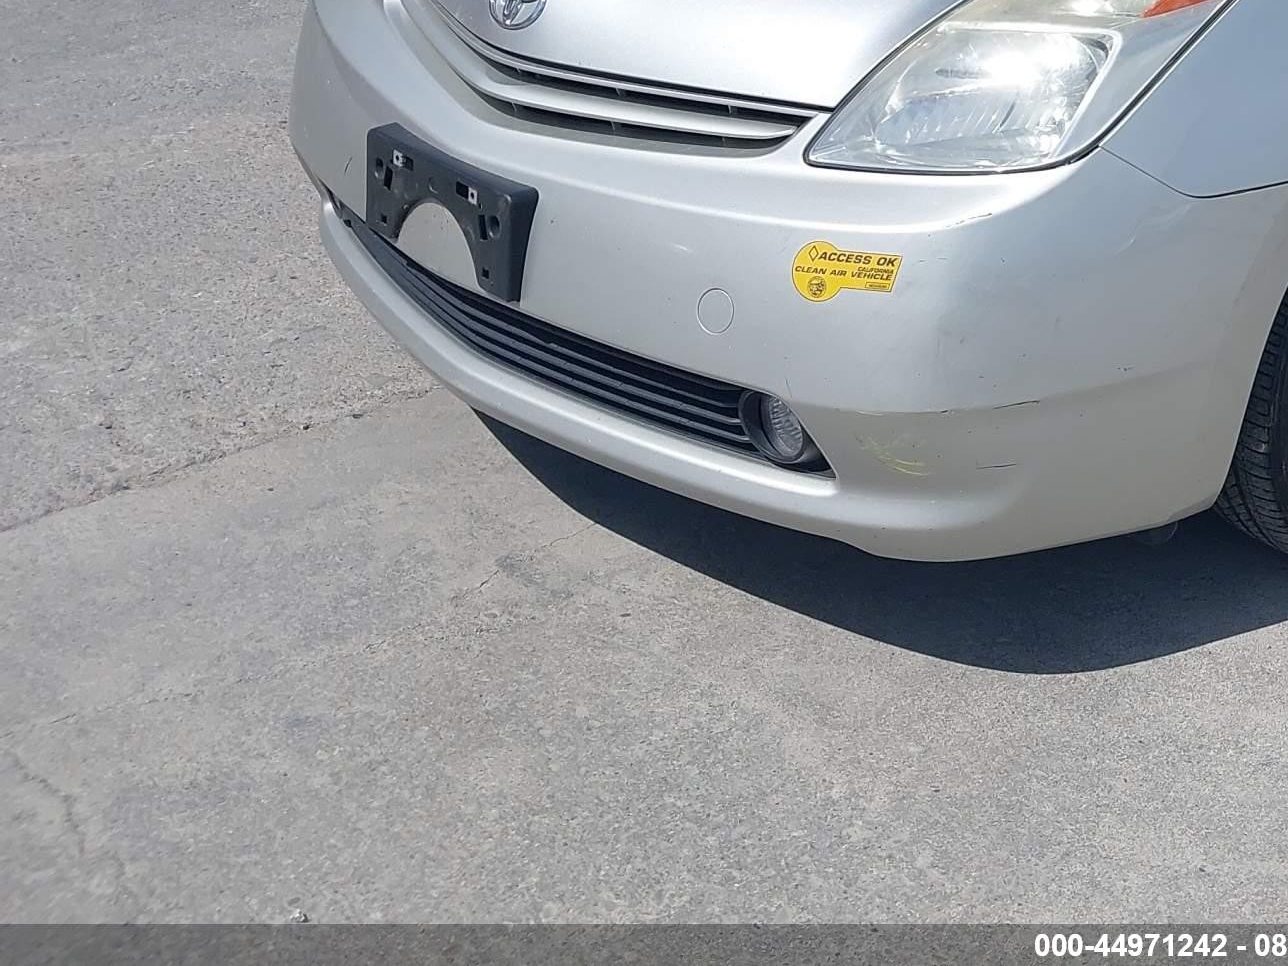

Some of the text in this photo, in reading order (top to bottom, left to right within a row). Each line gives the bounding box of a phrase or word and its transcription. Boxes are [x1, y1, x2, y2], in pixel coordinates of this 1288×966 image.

[818, 252, 898, 267] ACCESS OK
[795, 265, 893, 281] CLEAN AIR VEHICLE
[858, 266, 894, 274] CALIFORNIA
